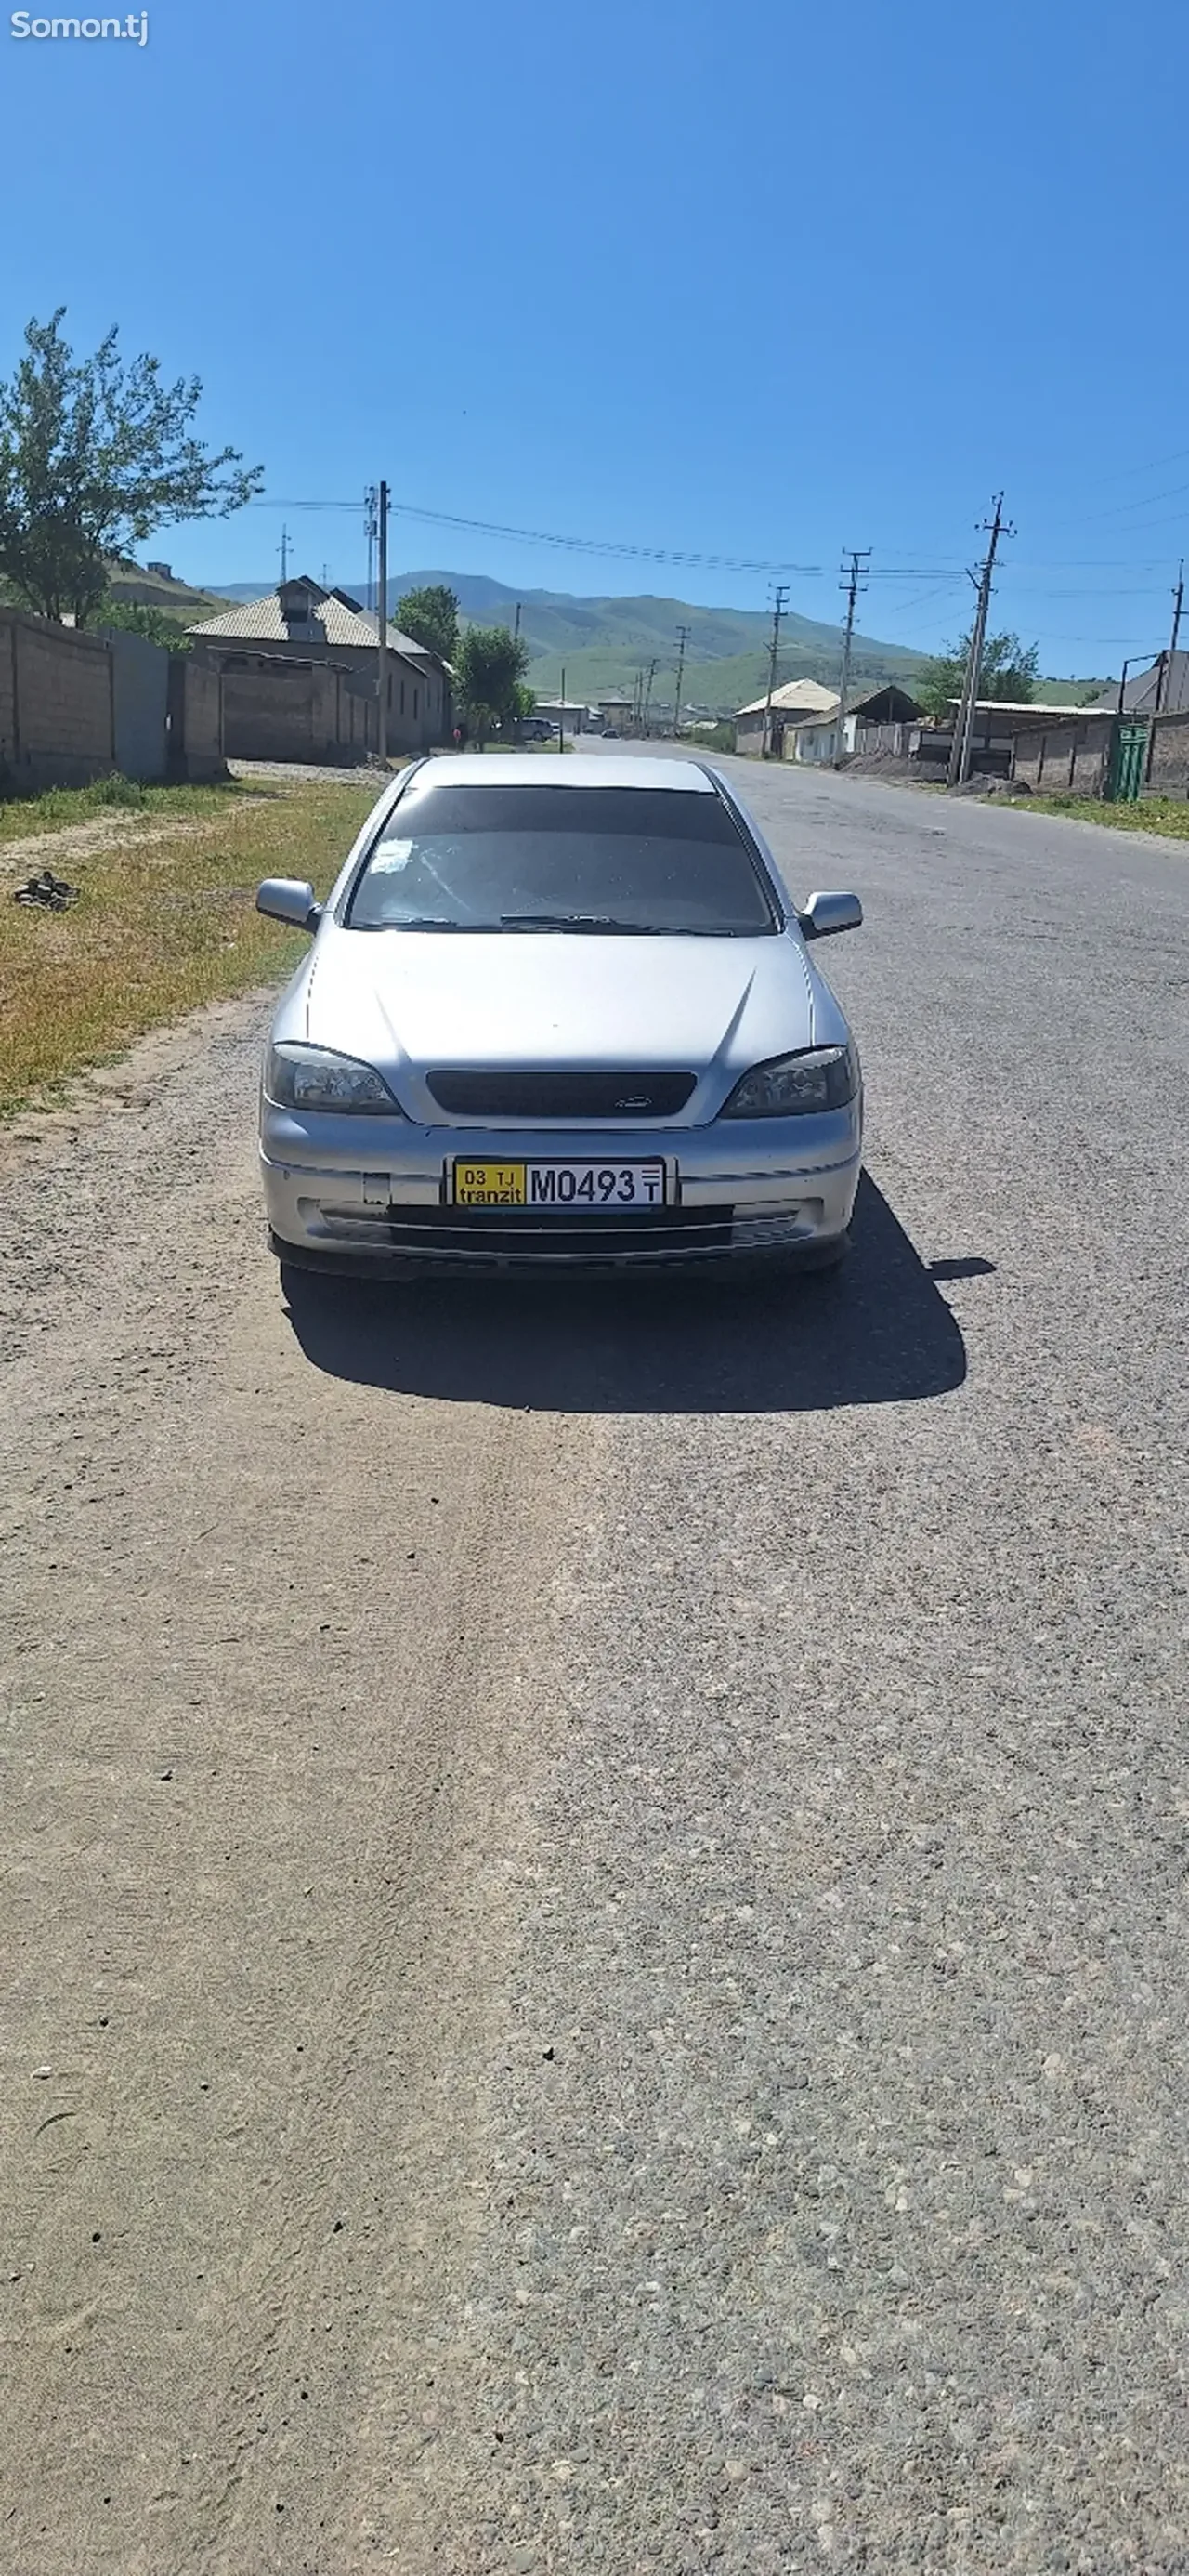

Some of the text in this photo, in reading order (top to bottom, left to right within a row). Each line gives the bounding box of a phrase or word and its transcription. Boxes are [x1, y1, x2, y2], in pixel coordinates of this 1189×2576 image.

[464, 1170, 515, 1186] 03 TJ
[460, 1189, 522, 1203] tranzit
[643, 1182, 660, 1202] T
